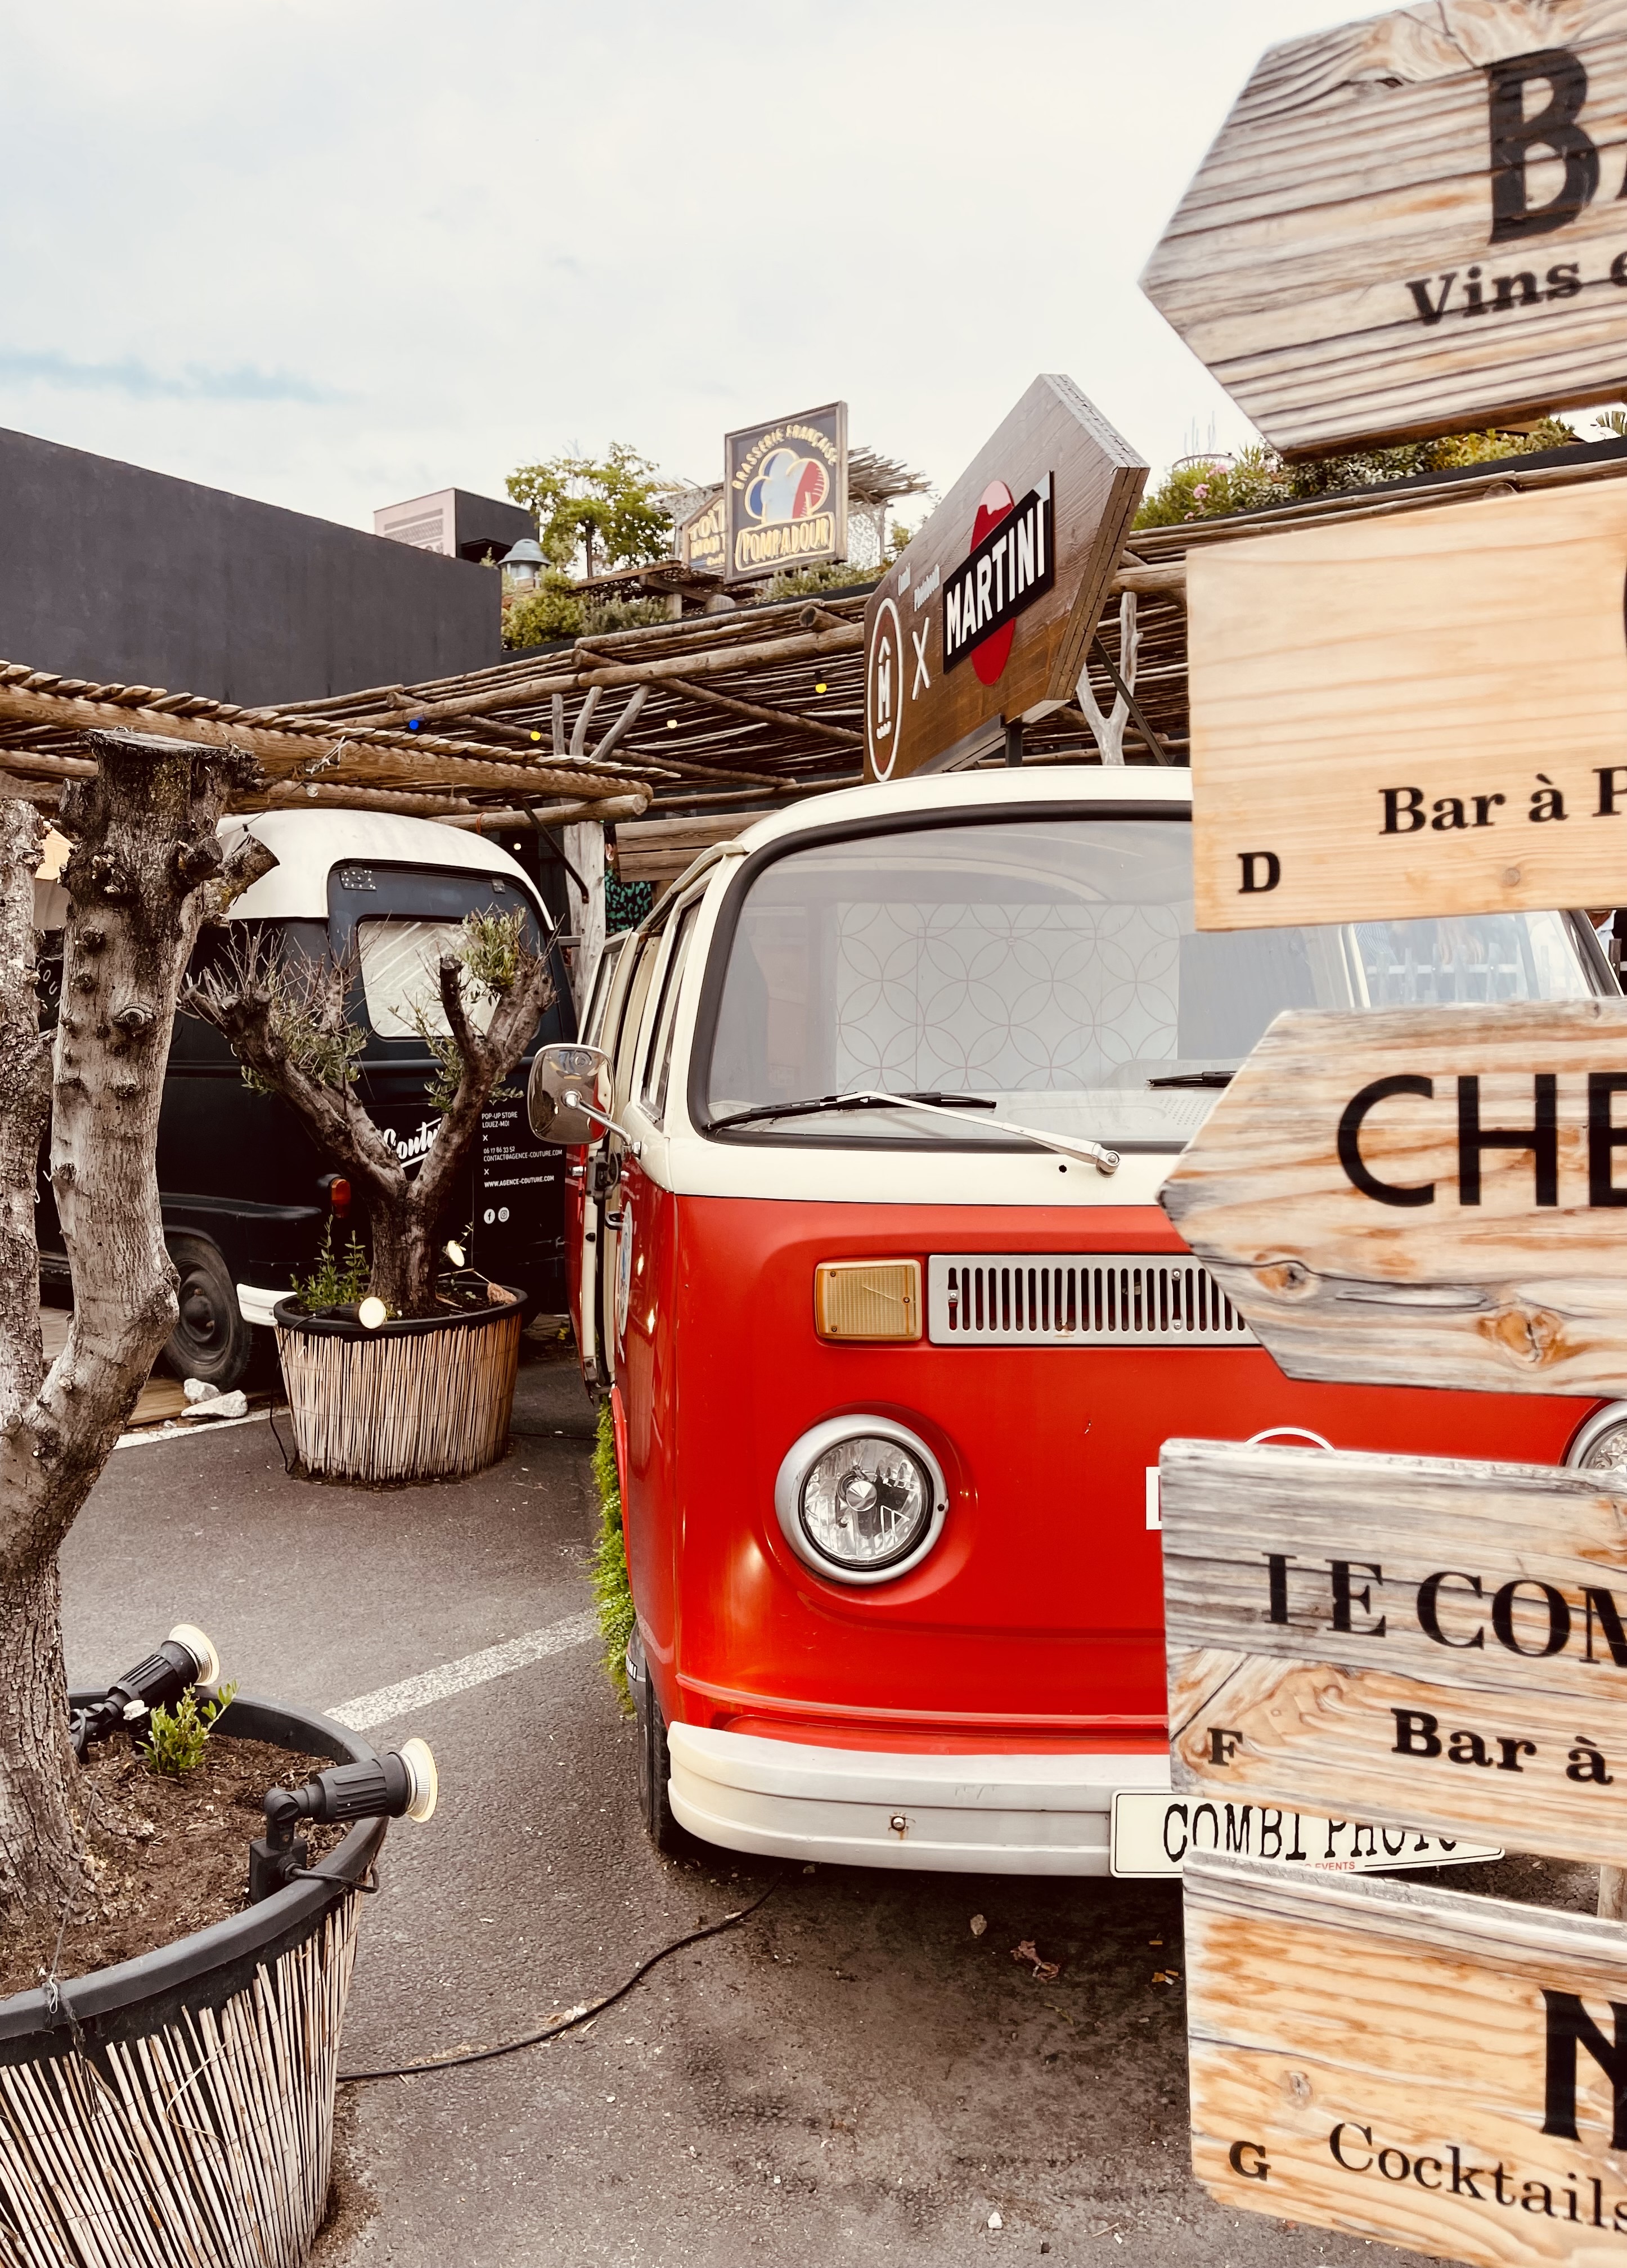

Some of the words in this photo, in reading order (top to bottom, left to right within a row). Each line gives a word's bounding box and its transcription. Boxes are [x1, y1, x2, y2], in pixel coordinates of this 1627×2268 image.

[1483, 48, 1627, 245] B
[1406, 259, 1583, 326] Vins
[732, 428, 785, 490] BRASSERIE
[743, 518, 829, 564] POMPADOUR
[947, 498, 1045, 655] MARTINI
[1378, 786, 1506, 835] Bar
[1529, 773, 1568, 822] à
[1237, 850, 1282, 893] D
[1337, 1072, 1627, 1207] CHE
[484, 1175, 554, 1187] WWW.AGENCE-COUTURE.COM
[1207, 1727, 1243, 1766] F
[1391, 1708, 1537, 1773] Bar
[1566, 1735, 1613, 1785] à
[1163, 1803, 1306, 1862] COMBI
[1228, 2140, 1271, 2181] G
